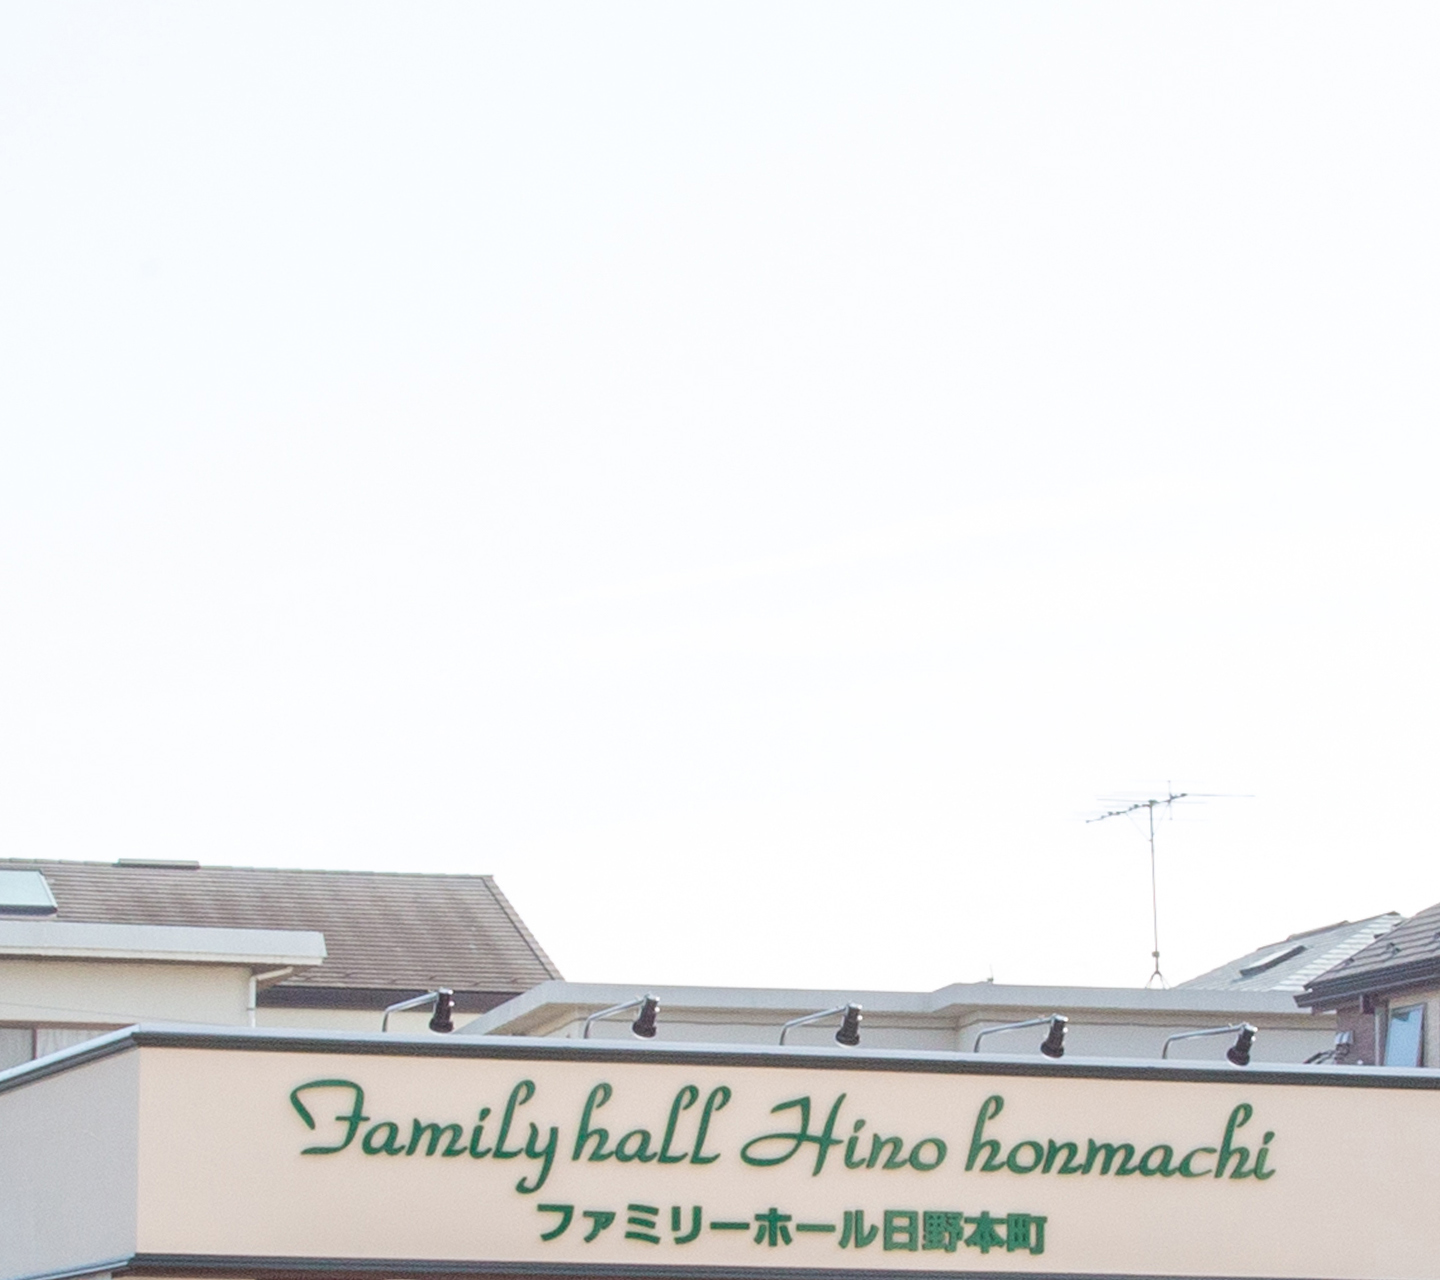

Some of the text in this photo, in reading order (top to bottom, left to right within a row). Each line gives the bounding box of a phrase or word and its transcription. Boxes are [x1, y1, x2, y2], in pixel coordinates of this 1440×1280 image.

[289, 1078, 1277, 1194] Family hall Hino honmachi
[536, 1203, 1047, 1255] ファミリーホール日野本町
